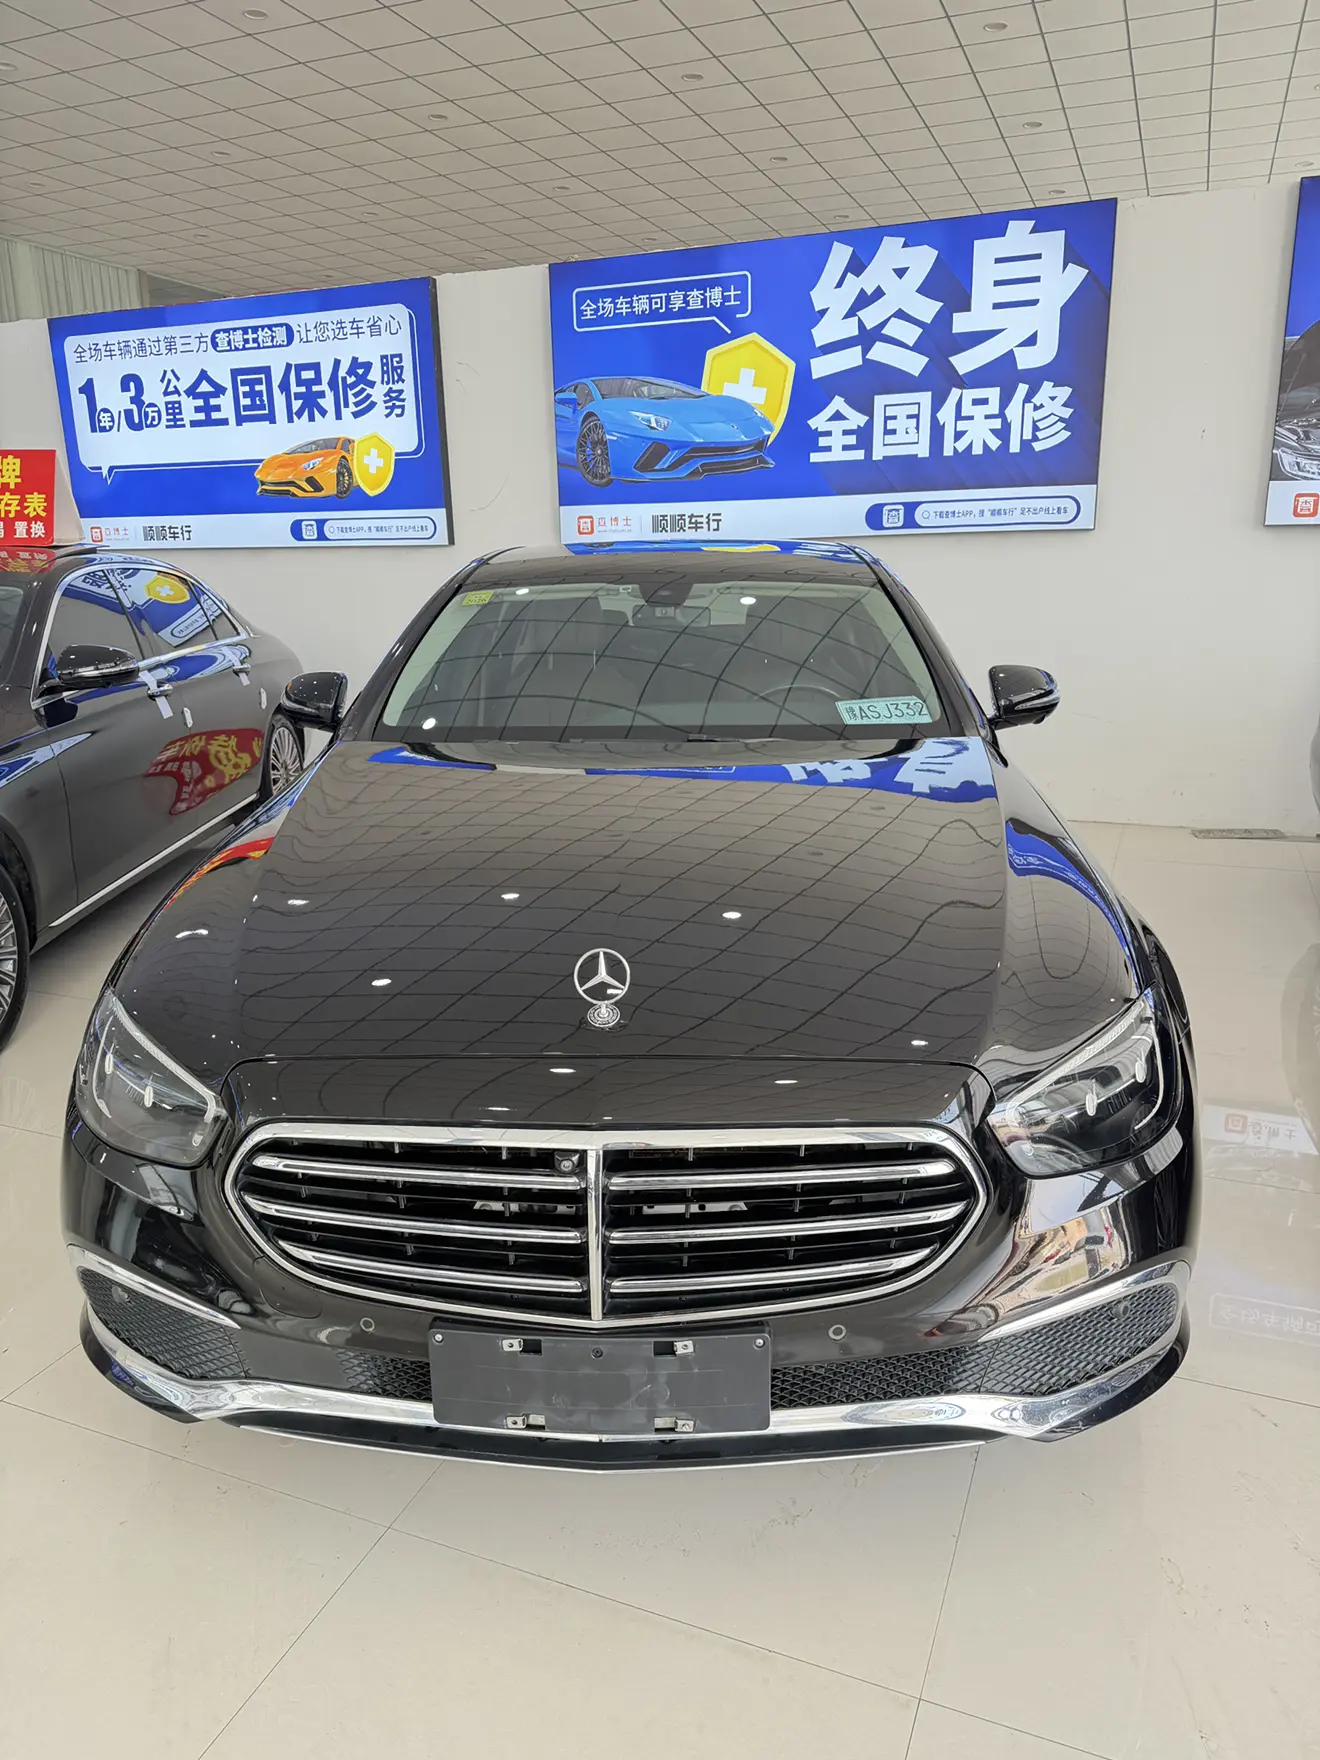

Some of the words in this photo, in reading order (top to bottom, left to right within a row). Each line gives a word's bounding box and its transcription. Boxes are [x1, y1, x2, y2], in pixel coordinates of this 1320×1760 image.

[580, 285, 741, 320] 全场车辆可享查博士
[809, 220, 1089, 380] 终身
[73, 333, 209, 364] 全场车辆通过第三方
[215, 326, 287, 351] 查博士检测
[296, 314, 402, 344] 让您选车省心
[807, 381, 1075, 463] 全国保修
[0, 492, 47, 518] 存表
[142, 525, 192, 541] 顺顺车行
[652, 513, 722, 534] 顺顺车行
